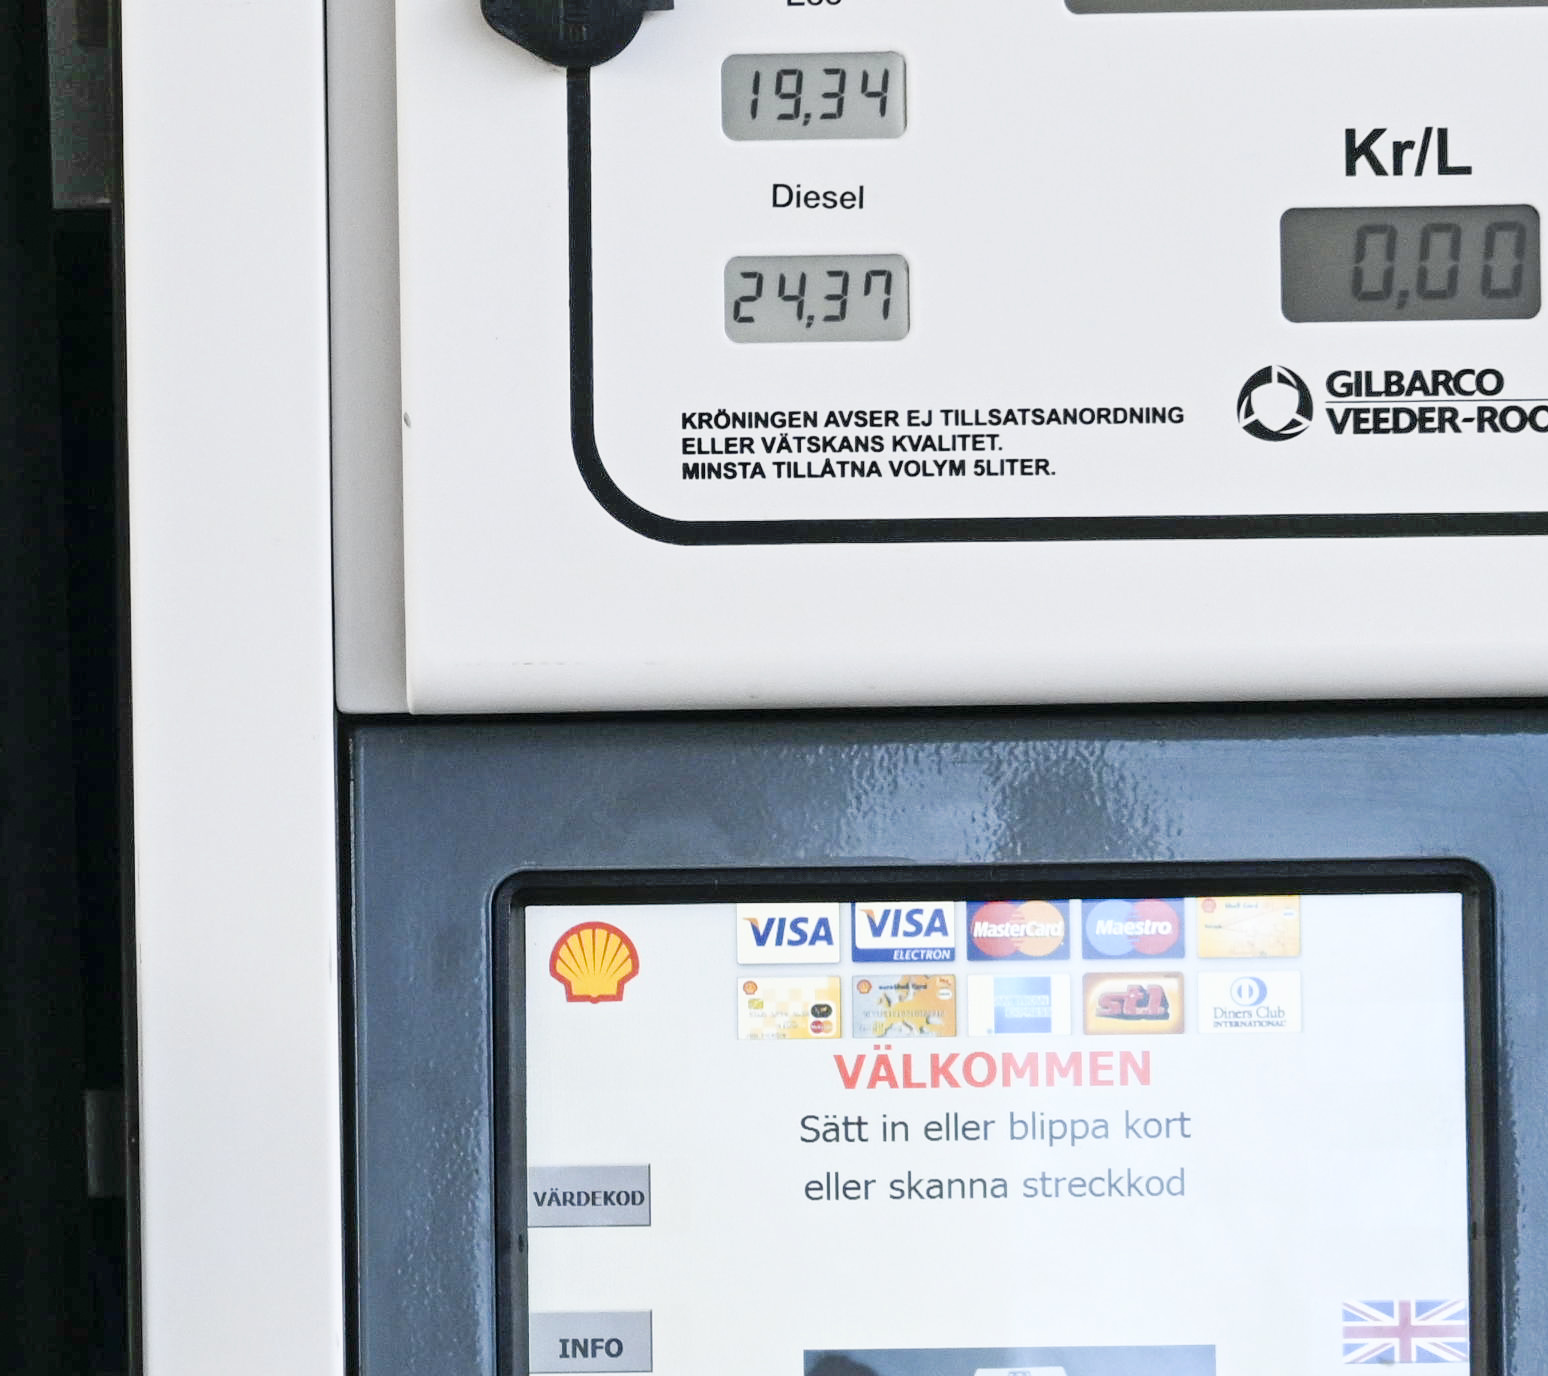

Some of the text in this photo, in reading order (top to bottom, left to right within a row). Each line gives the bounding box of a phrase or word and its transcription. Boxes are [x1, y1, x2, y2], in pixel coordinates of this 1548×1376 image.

[751, 68, 889, 126] 19,34
[1345, 127, 1472, 176] Kr/L
[773, 184, 863, 209] Diesel
[1352, 221, 1526, 309] 0,00
[733, 270, 892, 328] 24,37
[1326, 369, 1504, 398] GILBARCO
[682, 407, 1183, 429] KRÖNINGEN AVSER EJ TILLSATSANORDNING
[682, 433, 1002, 455] ELLER VÄTSKANS KVALITET.
[682, 458, 1055, 479] MINSTA TILLÅTNA VOLYM 5LITER.
[743, 916, 834, 947] VISA
[859, 907, 949, 938] VISA
[973, 920, 1064, 938] MasterCard
[1095, 919, 1173, 937] Maestro
[892, 948, 951, 961] ELECTRON
[1213, 1005, 1285, 1019] Diners Club
[833, 1044, 1150, 1089] VÄLKOMMEN
[801, 1111, 1191, 1146] Sätt in eller blippa kort
[534, 1188, 644, 1206] VÄRDEKOD
[805, 1168, 1184, 1200] eller skanna streckkod
[559, 1338, 623, 1358] INFO
